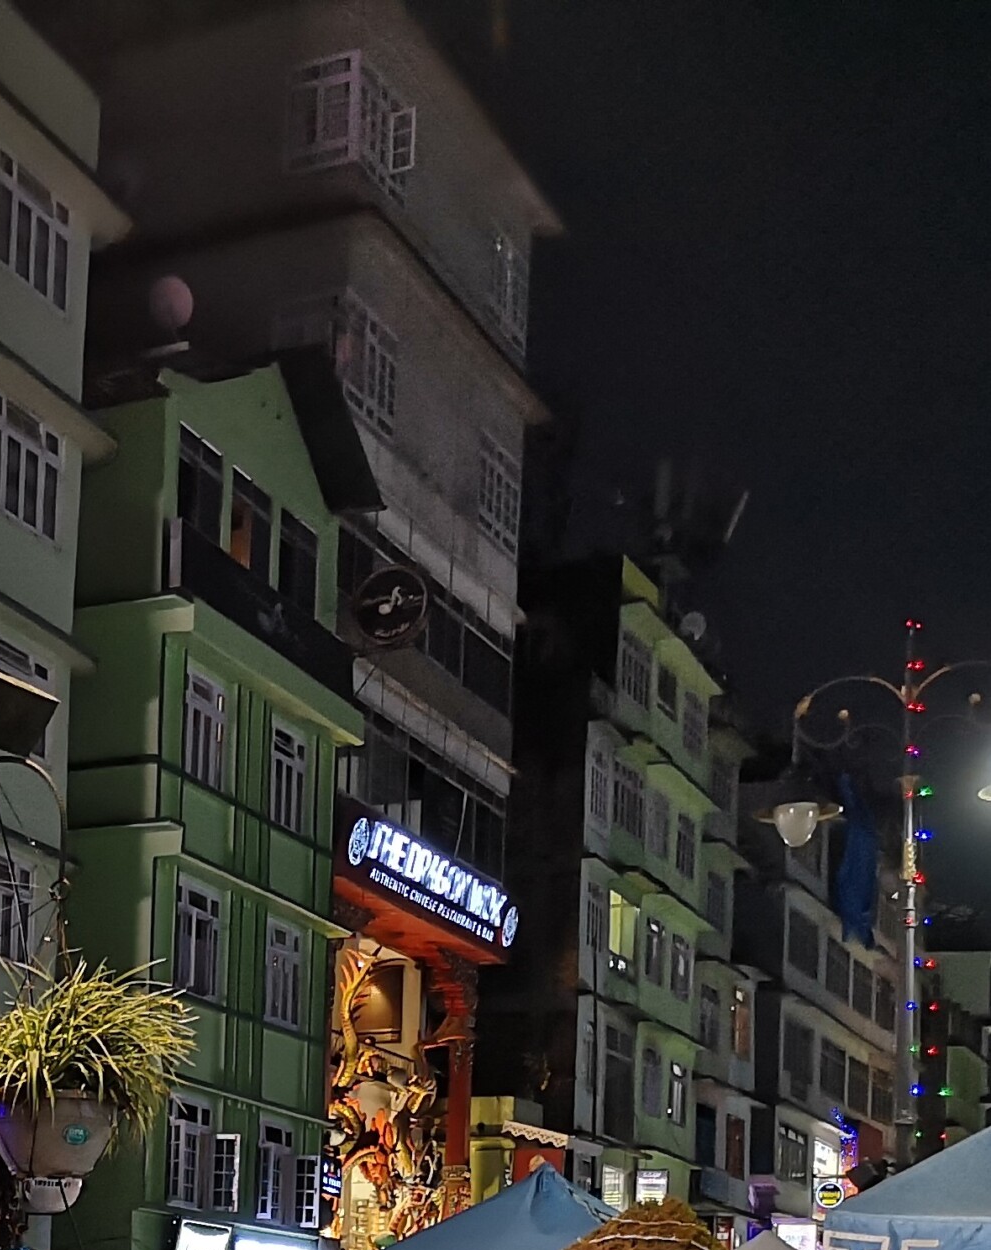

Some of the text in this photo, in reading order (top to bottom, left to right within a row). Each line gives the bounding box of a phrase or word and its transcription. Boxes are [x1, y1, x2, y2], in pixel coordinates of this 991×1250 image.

[367, 821, 410, 872] THE
[369, 868, 410, 897] AUTHENTIC
[410, 890, 436, 912] CHINESE
[437, 903, 477, 932] RESTAURANT
[482, 927, 495, 942] BAR
